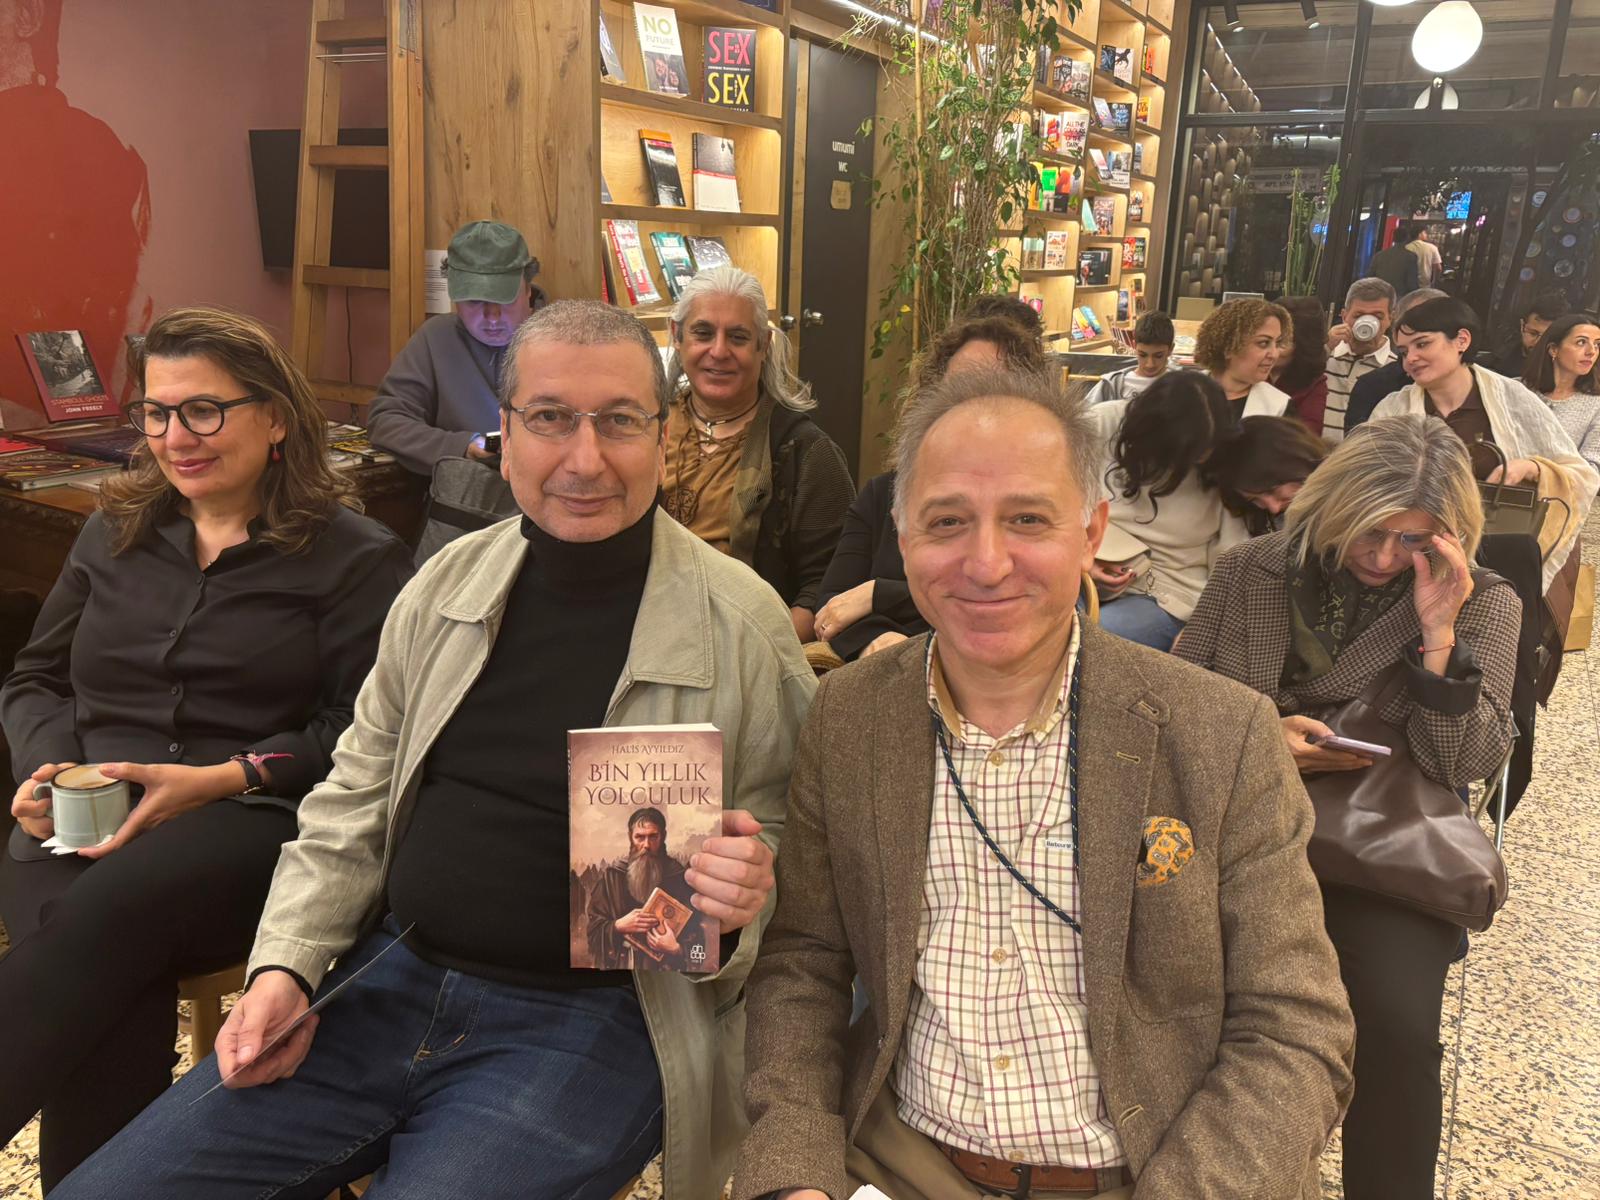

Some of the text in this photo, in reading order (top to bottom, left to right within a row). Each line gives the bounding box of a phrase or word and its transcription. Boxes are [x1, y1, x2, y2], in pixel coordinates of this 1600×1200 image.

[643, 15, 672, 35] NO
[646, 34, 674, 46] FUTURE
[708, 31, 751, 65] SEX
[707, 72, 750, 105] SEX
[838, 161, 848, 173] WC
[641, 744, 685, 756] AYYILDIZ
[588, 760, 629, 781] BİN
[637, 762, 707, 781] YILLIK
[584, 786, 712, 805] YOLCULUK
